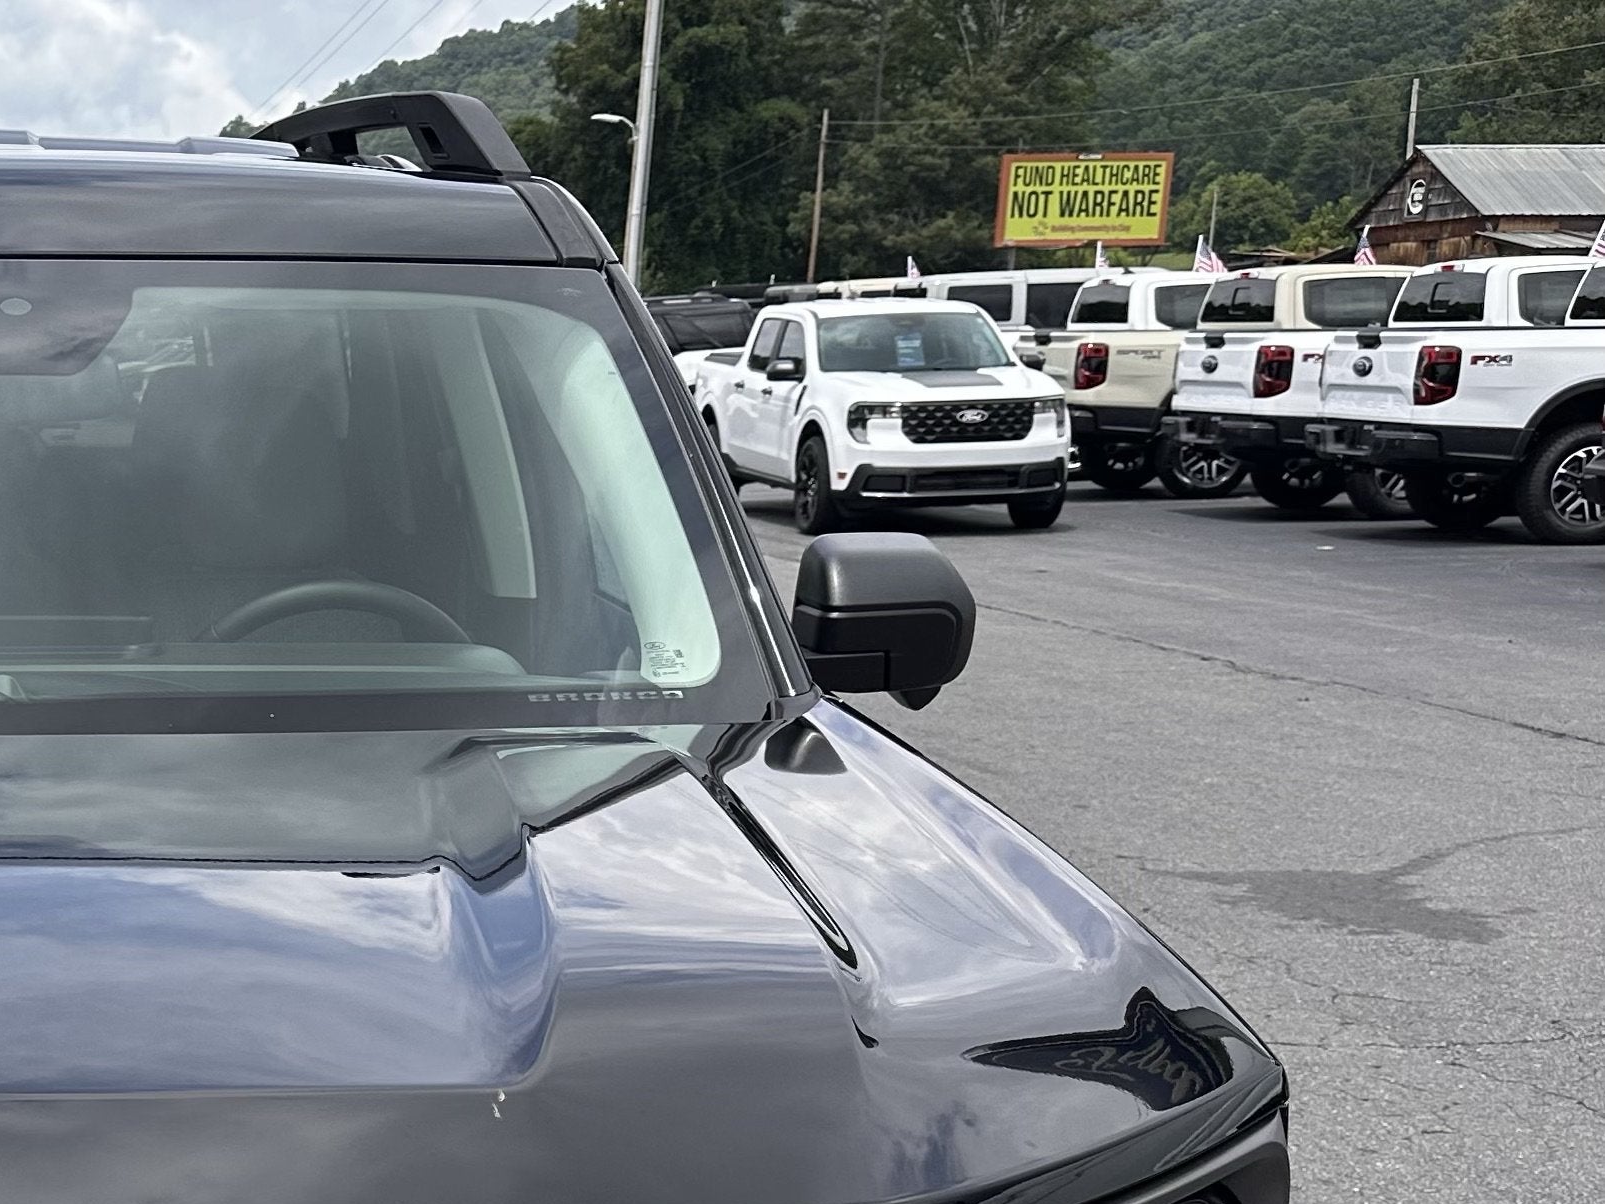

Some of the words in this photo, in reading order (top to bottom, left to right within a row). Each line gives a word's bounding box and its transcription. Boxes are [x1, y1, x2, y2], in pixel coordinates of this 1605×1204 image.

[1013, 165, 1055, 187] FUND
[1059, 163, 1162, 186] HEALTHCARE
[1010, 190, 1053, 218] NOT
[1059, 189, 1159, 218] WARFARE
[1302, 354, 1324, 363] FX
[1470, 355, 1512, 365] FX4
[527, 690, 684, 702] BRONCO
